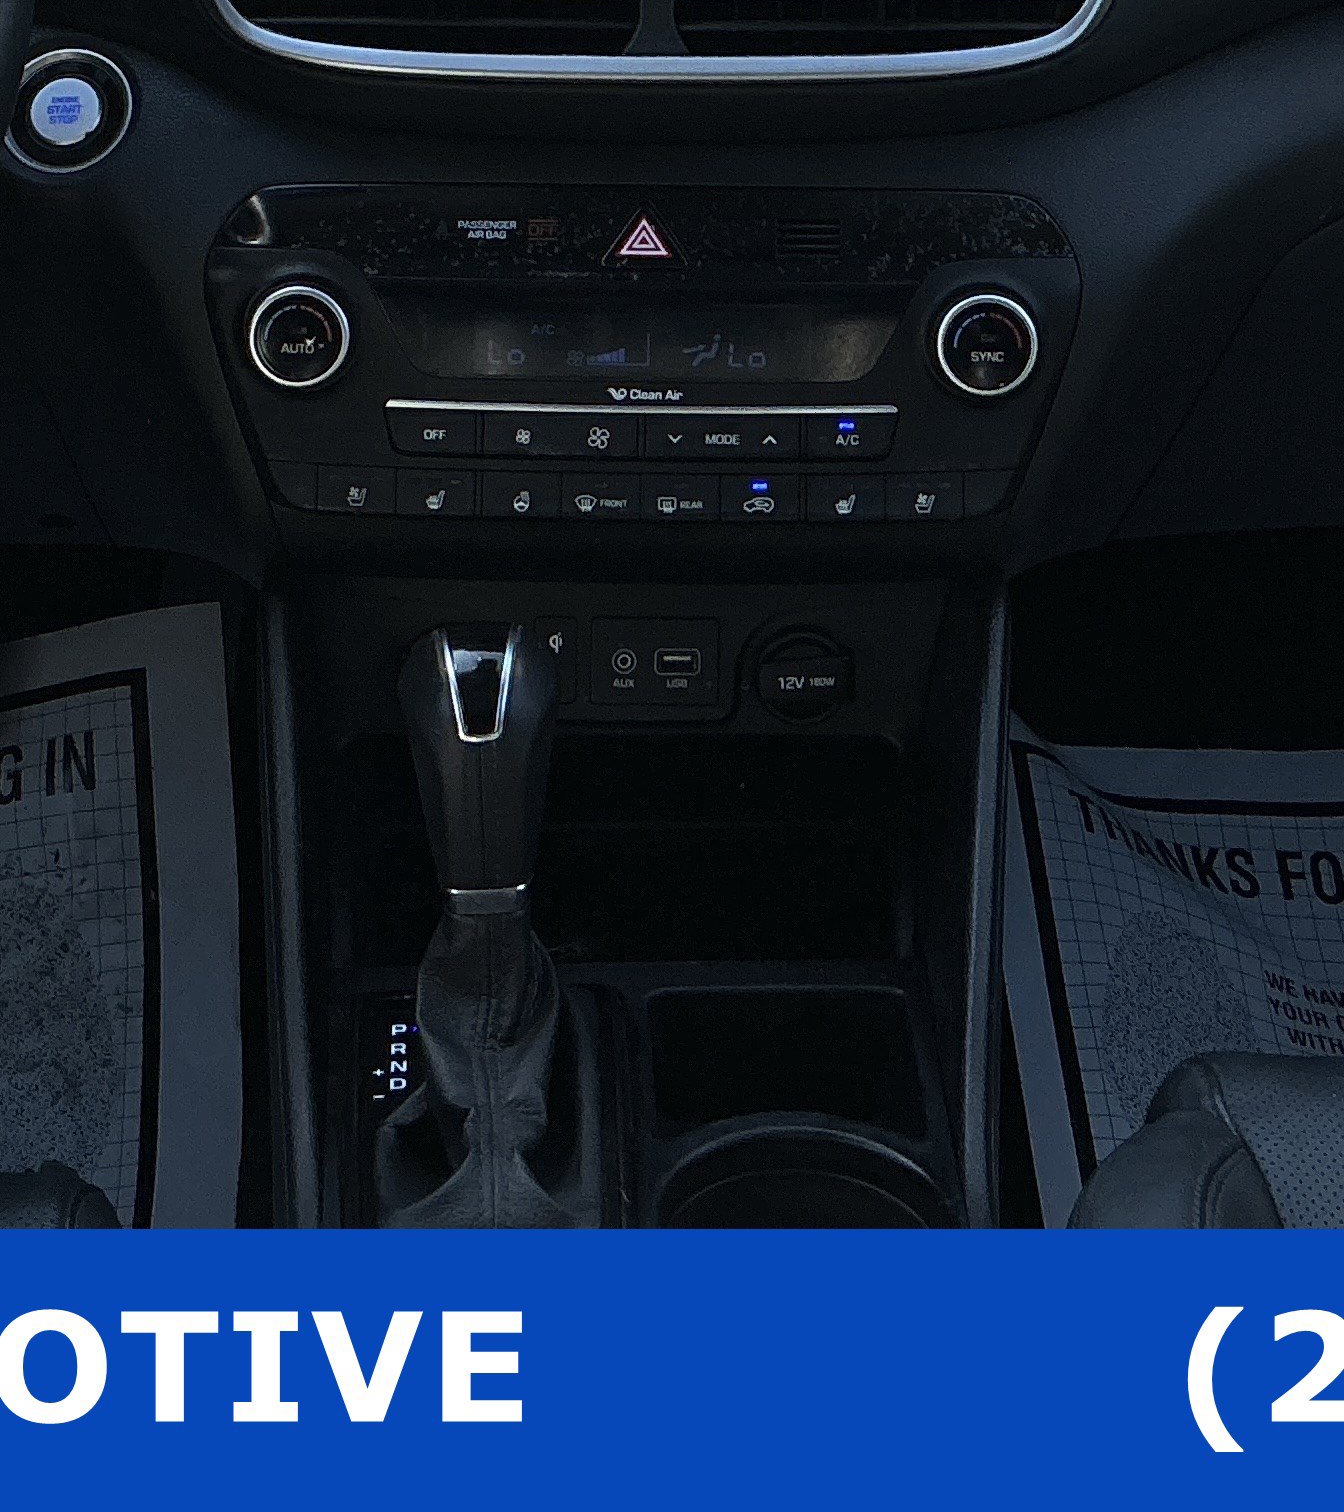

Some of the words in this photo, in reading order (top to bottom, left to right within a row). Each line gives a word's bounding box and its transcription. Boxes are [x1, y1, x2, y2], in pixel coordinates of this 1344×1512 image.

[46, 104, 82, 115] START
[49, 115, 79, 125] STOP
[457, 220, 517, 229] PASSENGER
[468, 230, 485, 239] AIR
[485, 230, 507, 239] BAG
[280, 342, 315, 355] AUTO
[970, 351, 1005, 362] SYNC
[629, 389, 663, 401] Clean
[665, 389, 684, 401] Air
[423, 429, 447, 440] OFF
[705, 433, 741, 445] MODE
[836, 433, 860, 446] A/C
[599, 498, 628, 508] FRONT
[680, 499, 703, 509] REAR
[613, 678, 635, 688] AUX
[777, 676, 805, 690] 12V
[809, 676, 836, 687] 180W
[45, 731, 96, 795] IN
[1067, 788, 1261, 901] THANKS
[1264, 969, 1299, 999] WE
[1268, 995, 1330, 1029] YOUR
[391, 1023, 408, 1036] P
[390, 1042, 407, 1056] R
[390, 1059, 408, 1073] N
[389, 1077, 407, 1091] D
